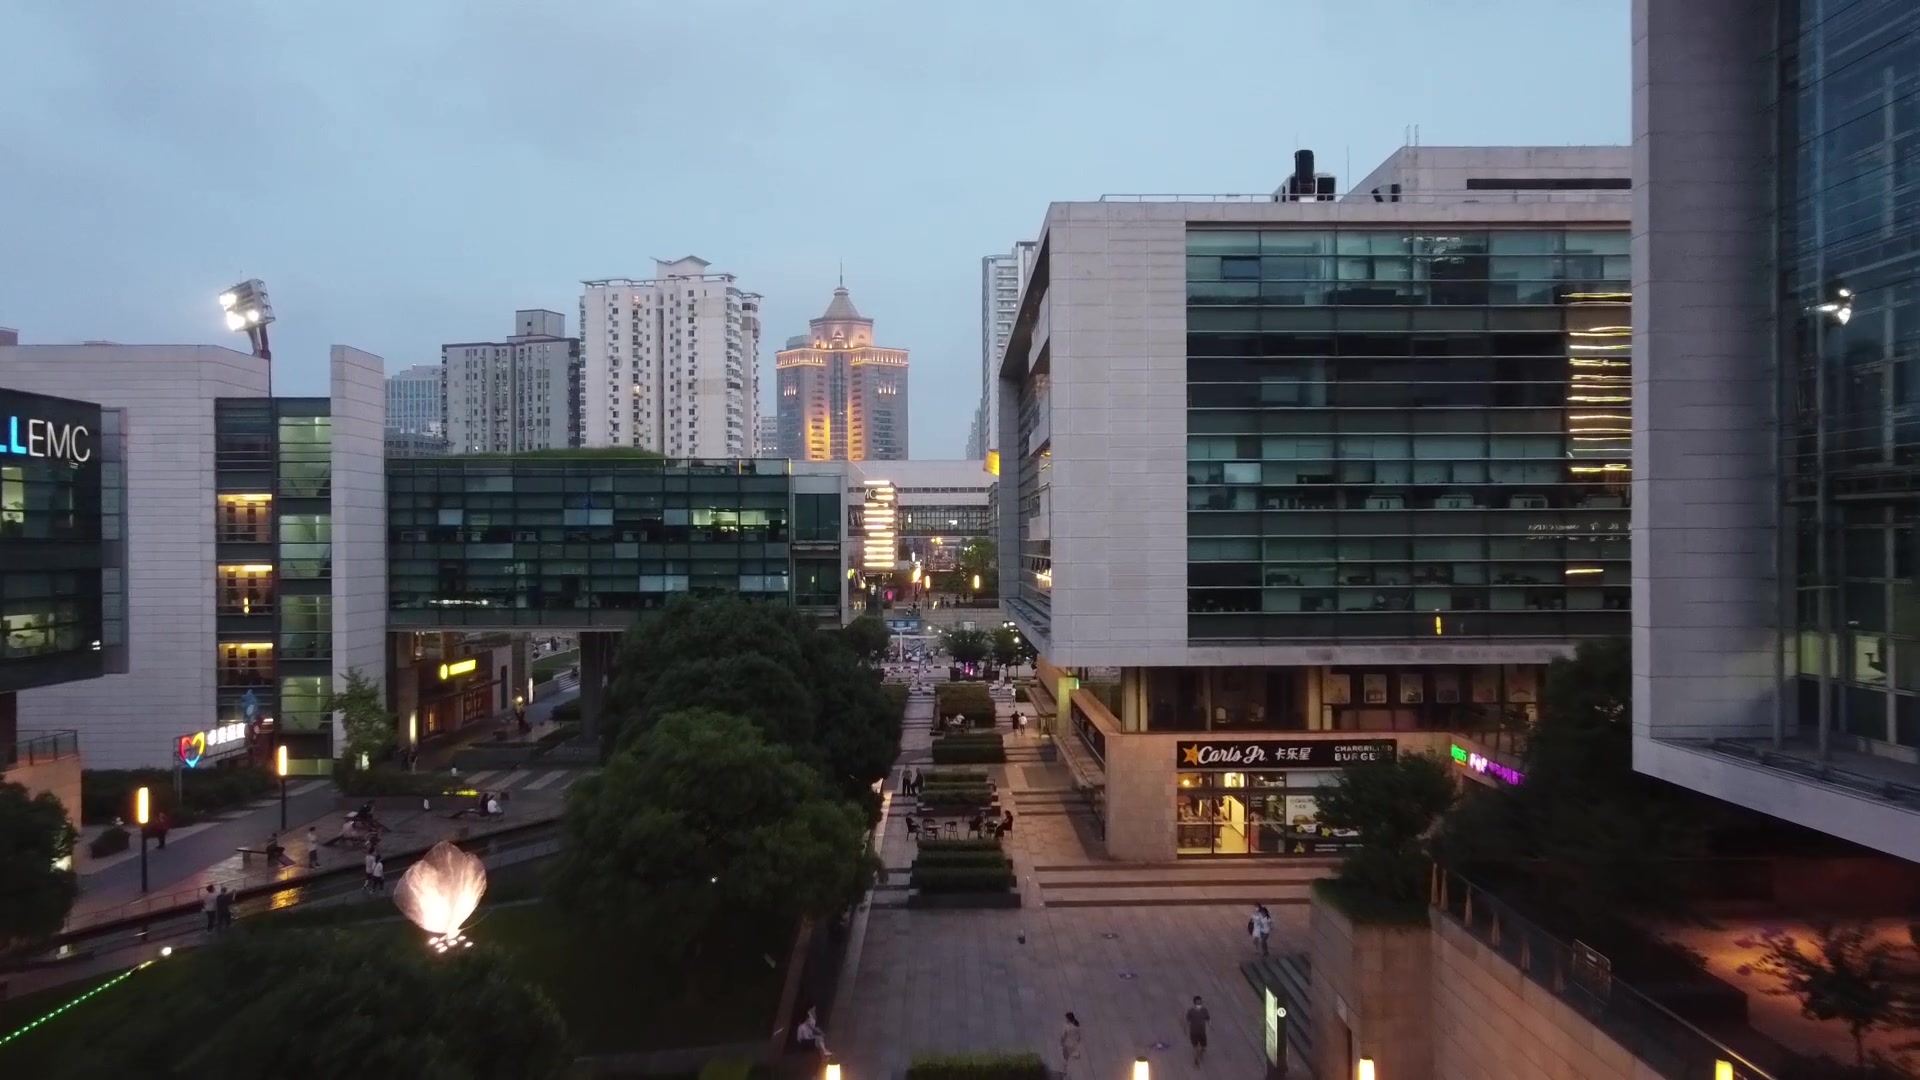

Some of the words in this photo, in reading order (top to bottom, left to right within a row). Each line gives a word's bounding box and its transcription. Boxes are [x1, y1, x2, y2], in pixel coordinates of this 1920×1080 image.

[1198, 745, 1242, 764] Carl's
[1275, 747, 1312, 760] 卡乐星
